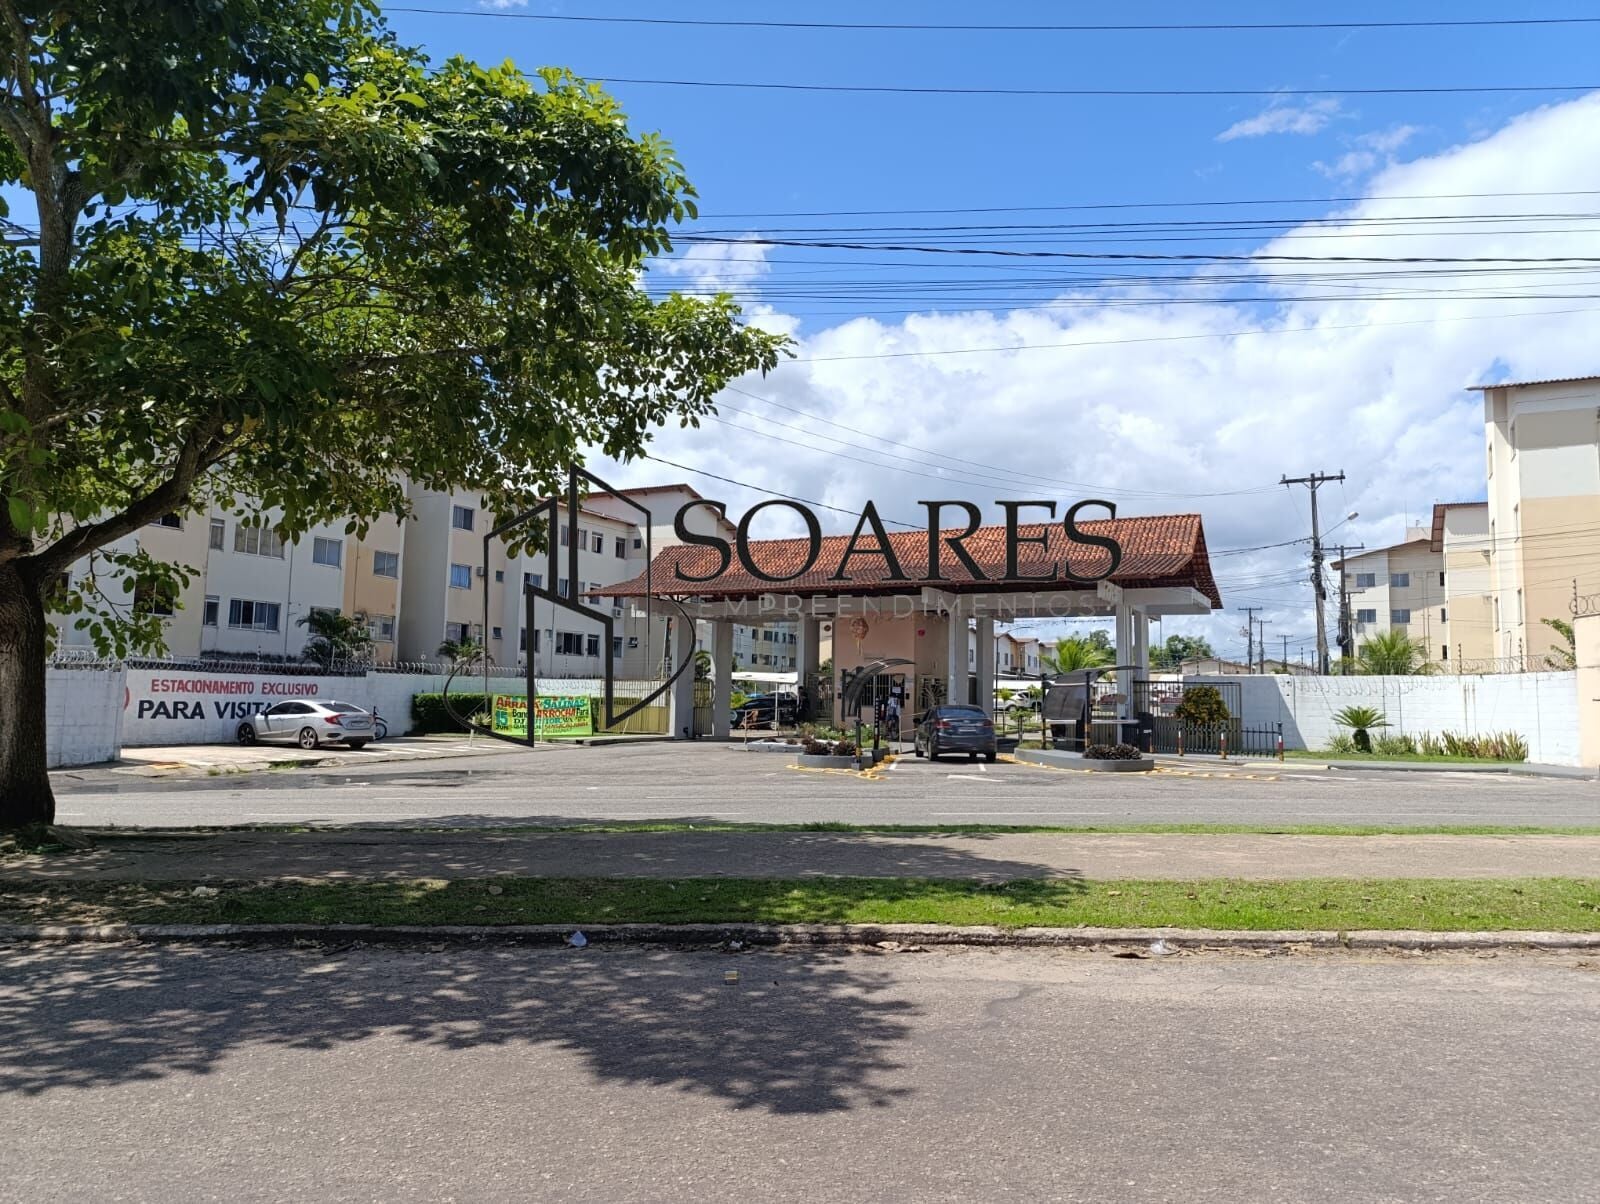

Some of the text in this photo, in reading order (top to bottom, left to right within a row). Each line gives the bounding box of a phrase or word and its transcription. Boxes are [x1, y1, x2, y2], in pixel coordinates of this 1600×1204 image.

[151, 679, 318, 695] ESTACIONAMENTO EXCLUSIVO
[137, 699, 205, 720] PARA
[543, 698, 585, 709] SALINAS
[495, 710, 508, 725] 15
